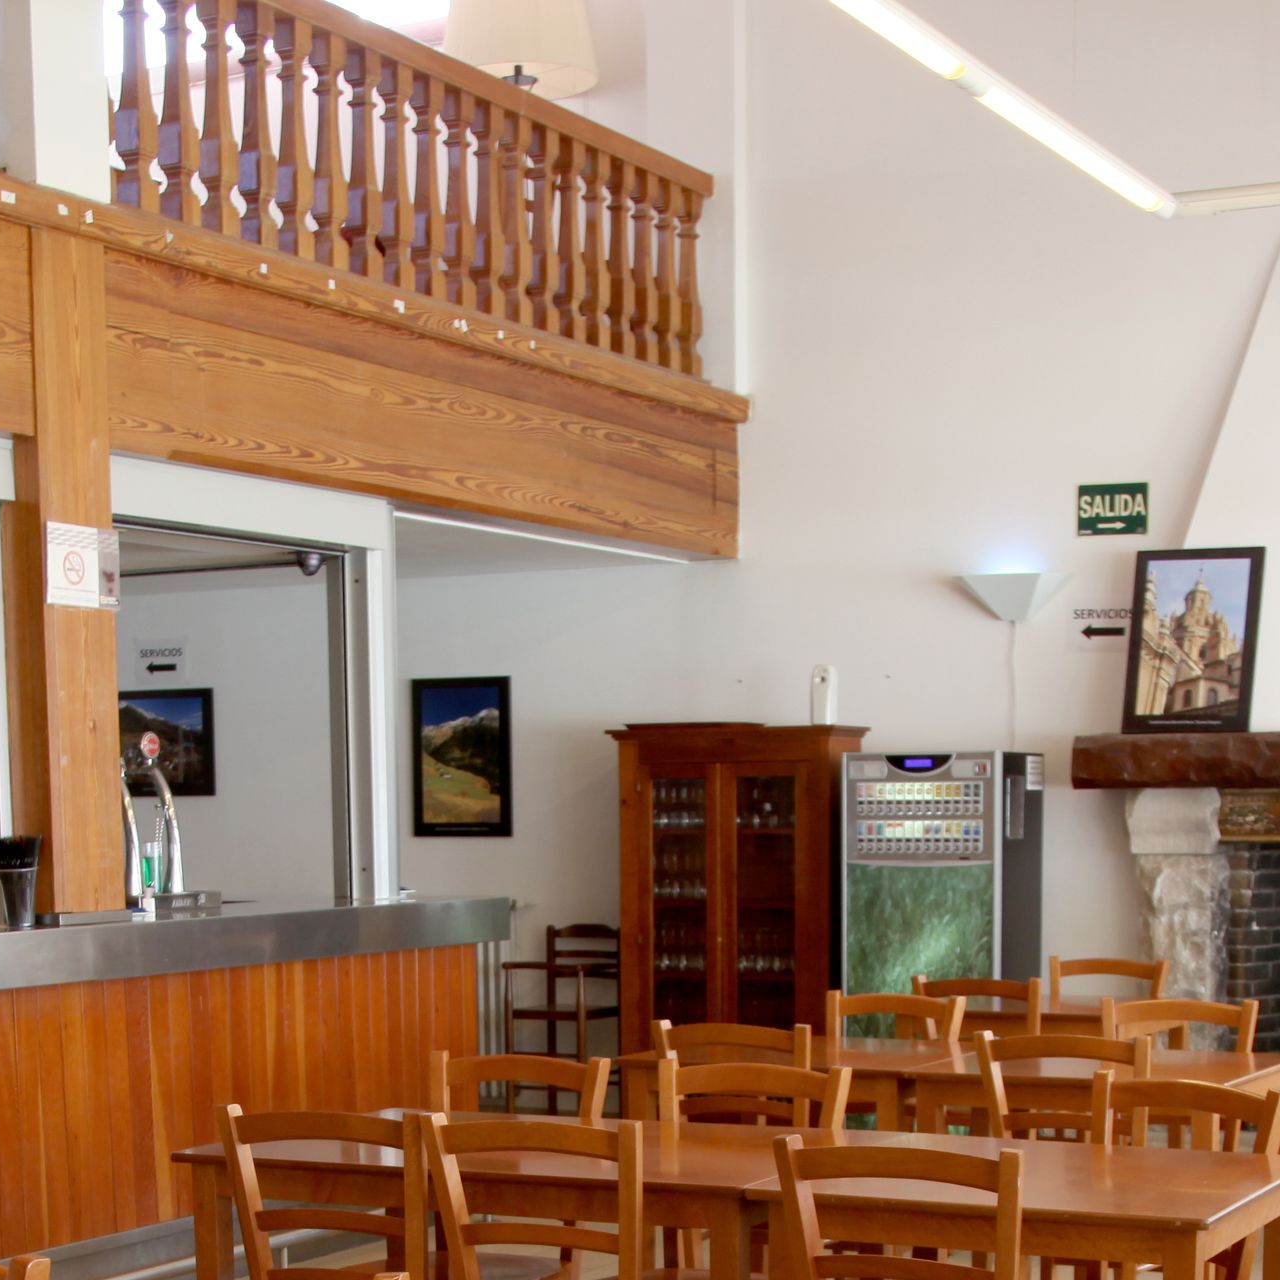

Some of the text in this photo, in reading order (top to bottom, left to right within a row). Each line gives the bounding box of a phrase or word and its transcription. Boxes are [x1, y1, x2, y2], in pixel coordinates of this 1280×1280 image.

[1079, 493, 1146, 518] SALIDA
[1073, 608, 1133, 620] SERVICIOS
[140, 647, 183, 658] SERVICIOS
